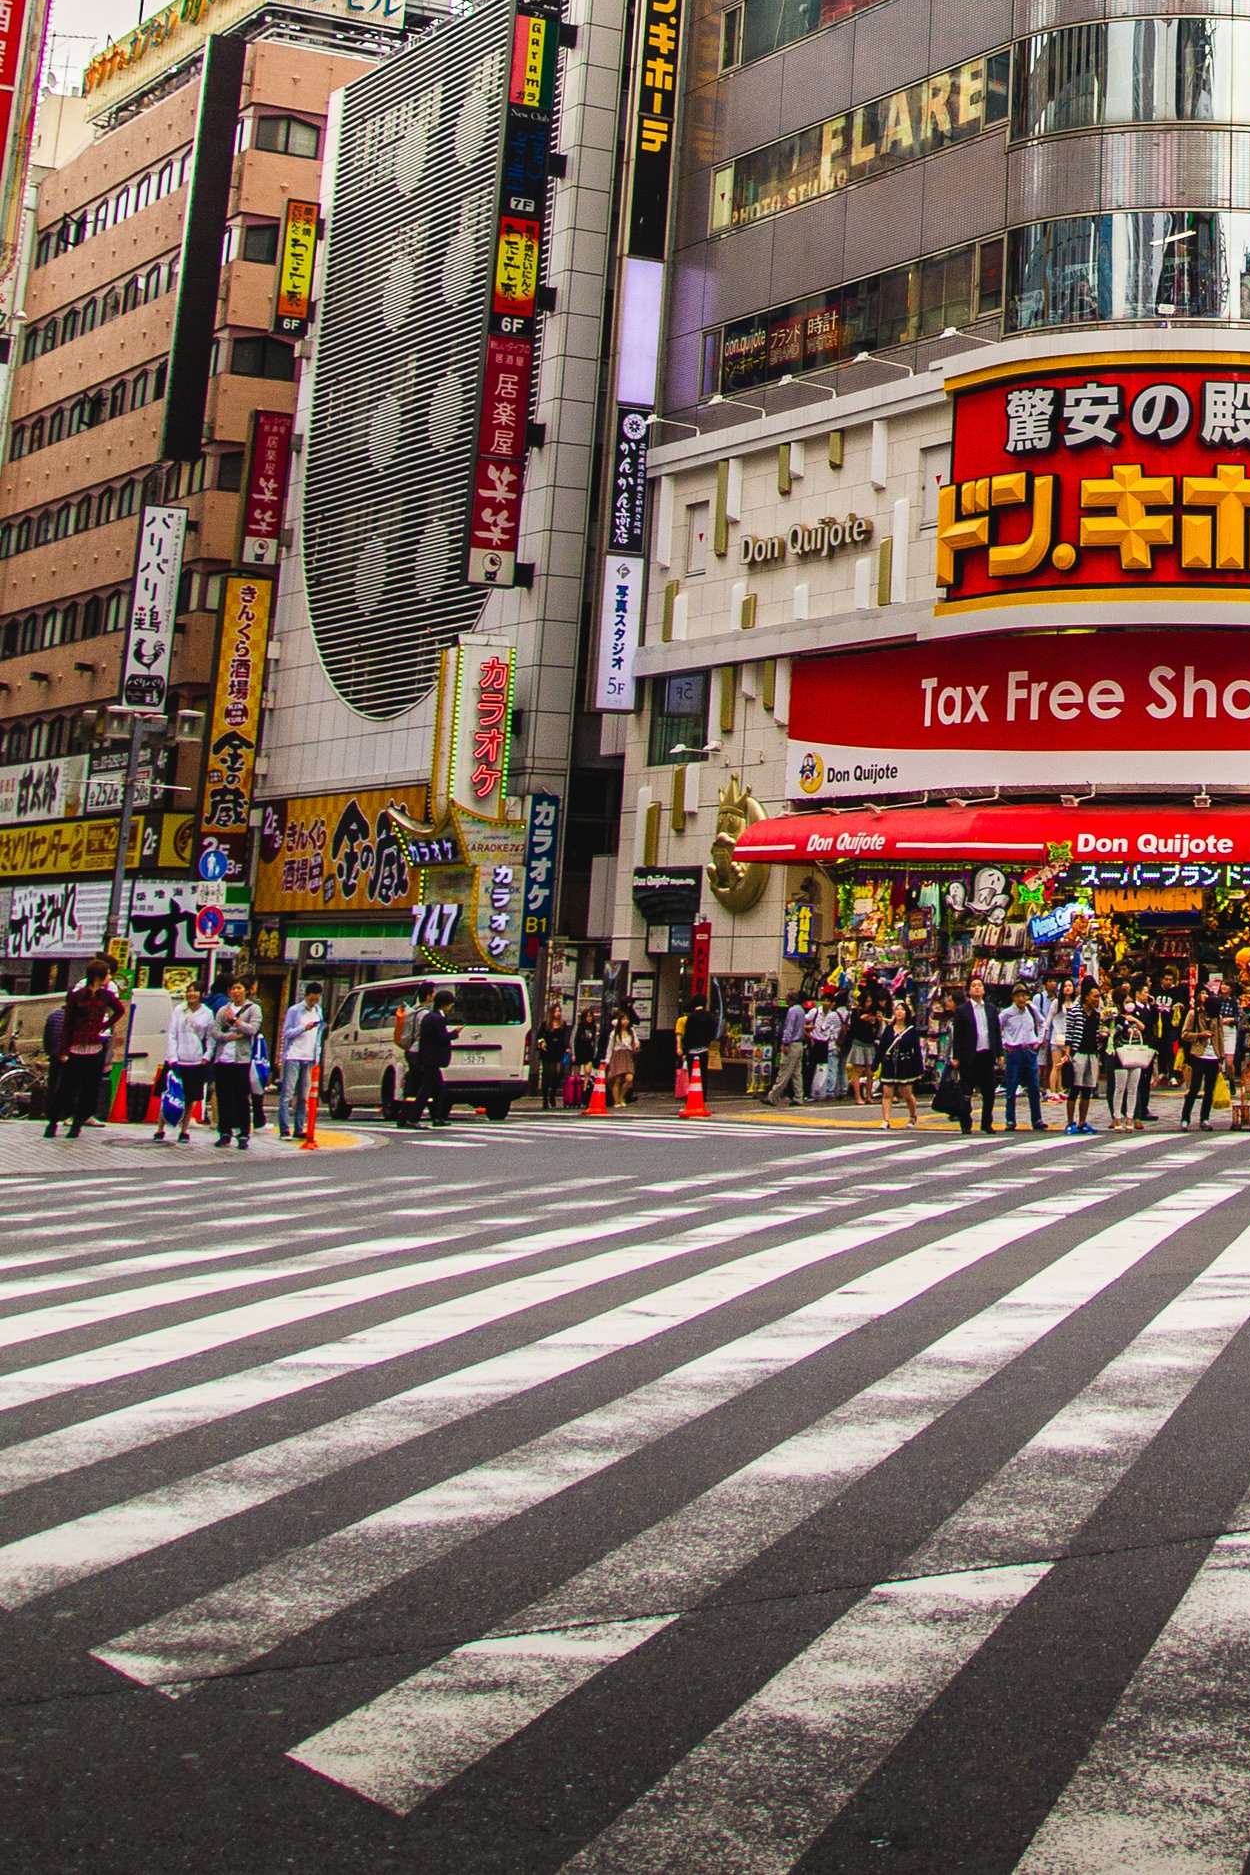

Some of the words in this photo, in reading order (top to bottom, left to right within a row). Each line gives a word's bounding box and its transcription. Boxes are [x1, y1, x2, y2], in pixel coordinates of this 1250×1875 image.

[819, 59, 983, 184] FLARE
[511, 197, 535, 212] 7F
[282, 318, 300, 331] 6F
[501, 317, 525, 333] 6F
[807, 310, 839, 335] 時計
[490, 373, 519, 455] 居楽屋
[613, 441, 637, 545] かんかん商店
[740, 530, 785, 566] Don
[786, 511, 873, 560] Quijote
[133, 513, 175, 634] バリバリ鶏
[227, 584, 258, 701] きんくら酒場
[611, 584, 629, 671] 写真スタジオ
[606, 678, 625, 695] 5F
[921, 676, 990, 727] Tax
[1005, 669, 1126, 723] Free
[470, 655, 508, 799] カラオケ
[204, 729, 255, 827] 金の蔵
[827, 766, 850, 783] Don
[853, 764, 898, 785] Quijote
[286, 817, 327, 854] きんくら
[527, 801, 556, 911] カラオケ
[806, 834, 835, 853] Don
[835, 832, 886, 855] Quijote
[1077, 834, 1129, 856] Don
[1136, 832, 1234, 860] Quijote
[410, 903, 459, 946] 747
[489, 865, 514, 956] カラオケ
[525, 916, 547, 933] B1
[1094, 887, 1203, 915] HALLOWEEN
